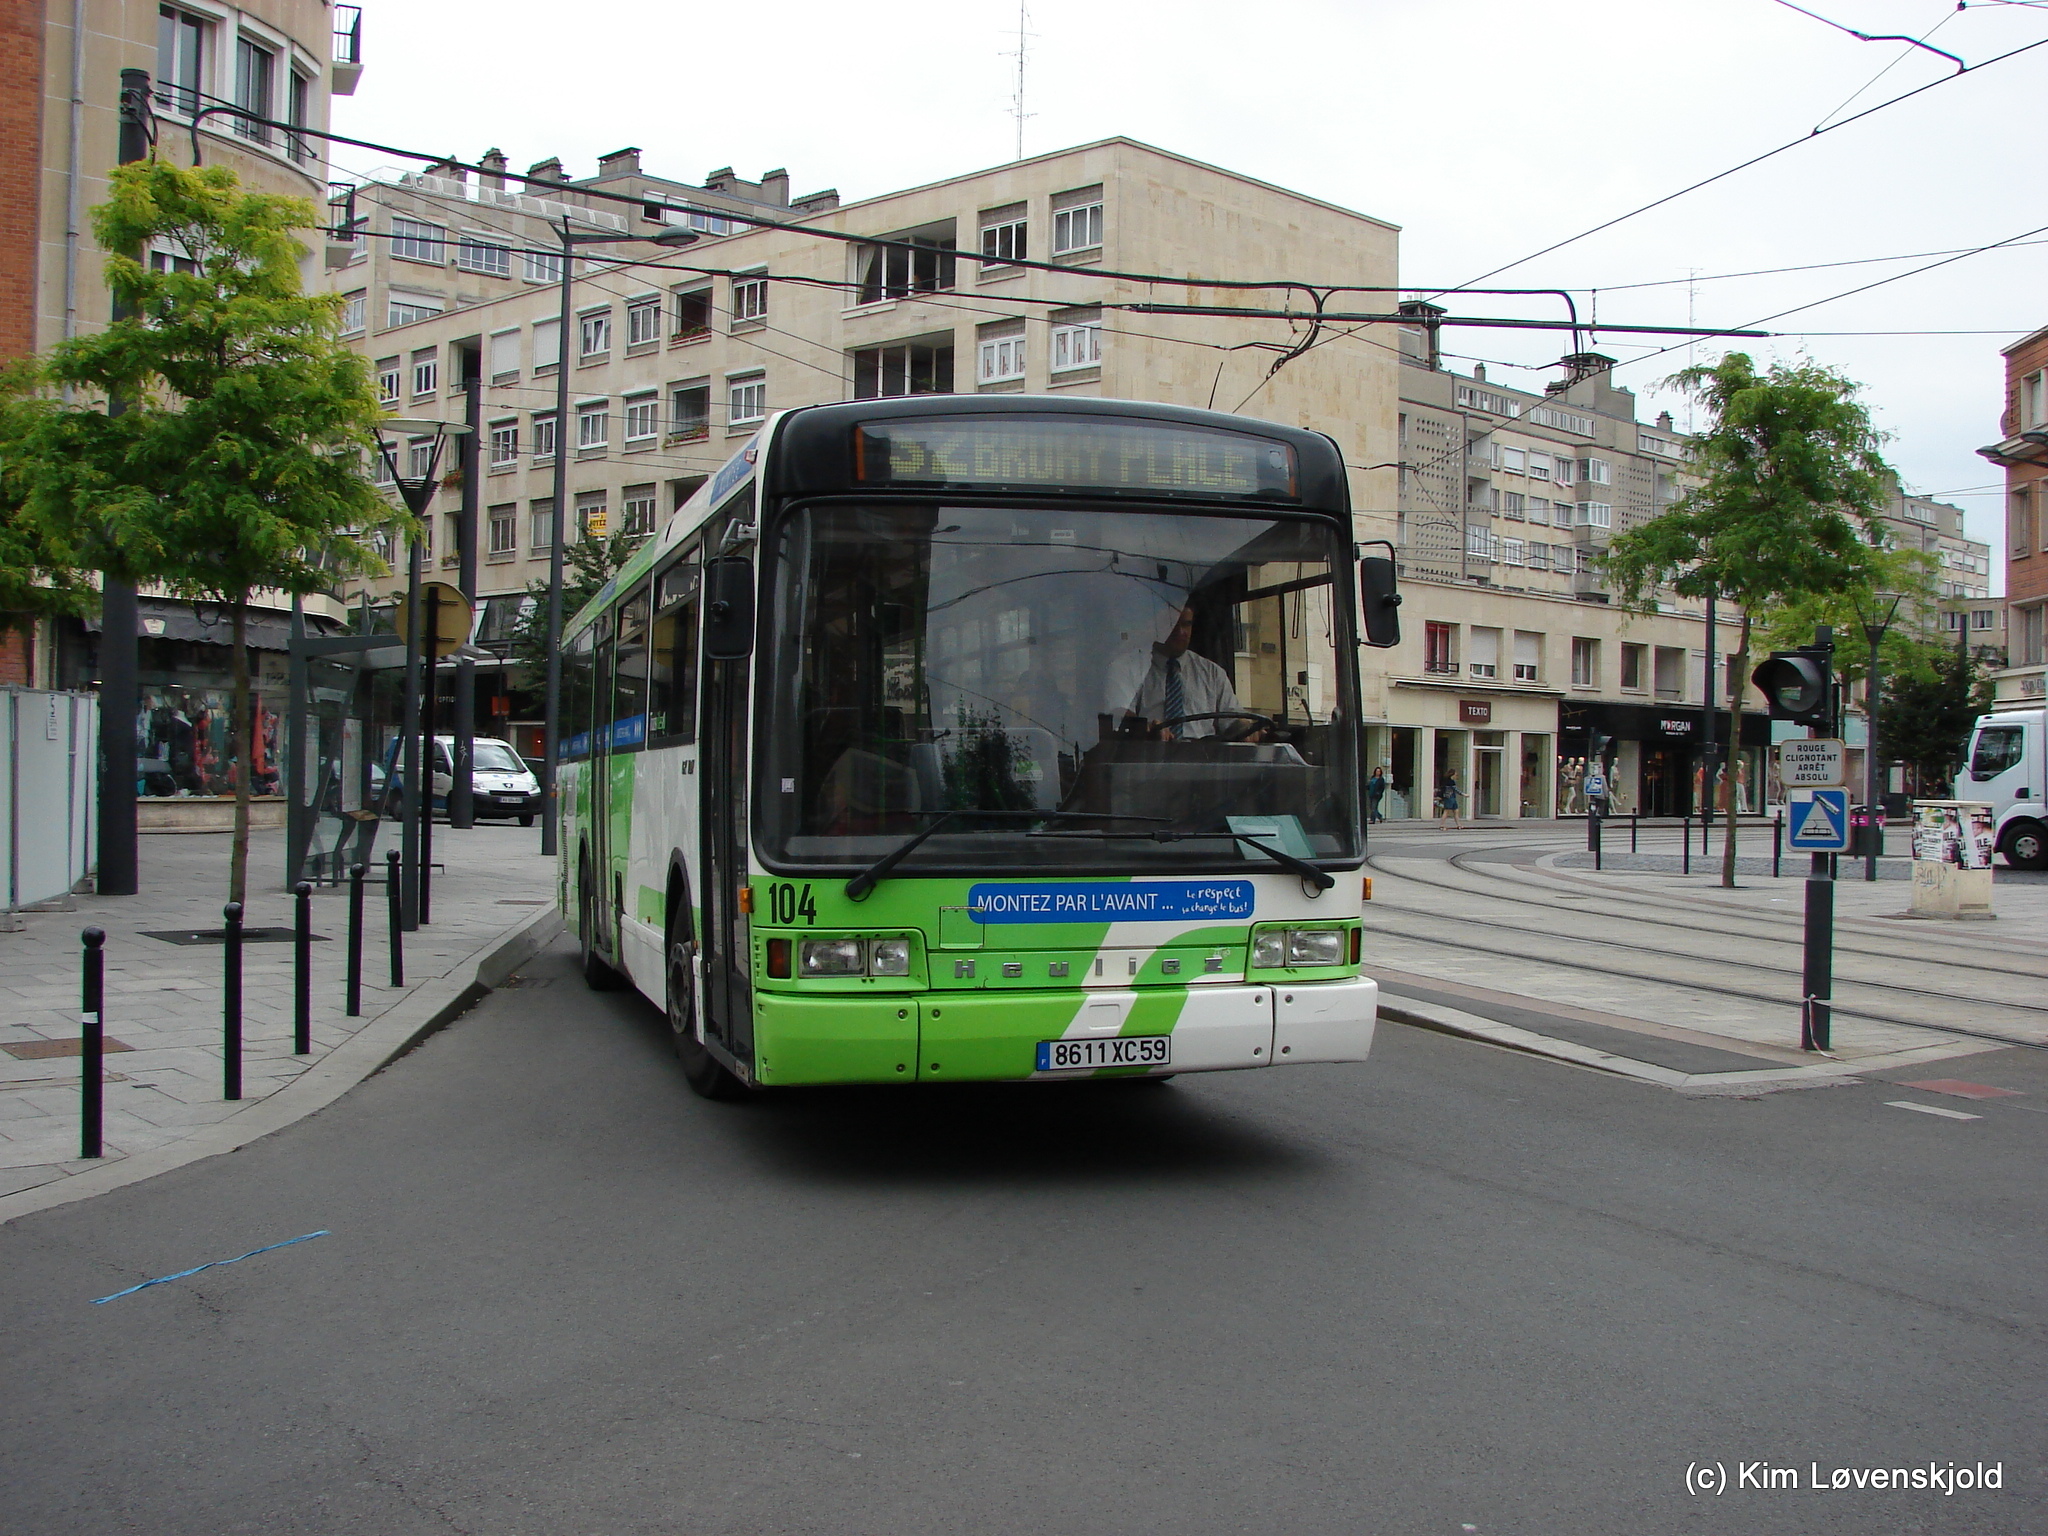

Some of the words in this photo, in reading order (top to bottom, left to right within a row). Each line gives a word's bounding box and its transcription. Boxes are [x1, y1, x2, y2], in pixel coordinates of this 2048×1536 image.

[1467, 706, 1488, 716] TEXTO
[1797, 744, 1826, 752] ROUGE
[1785, 754, 1838, 762] CLIGNOTANT
[1797, 763, 1825, 771] ARRÊT
[1794, 773, 1828, 781] ABSOLU
[1198, 886, 1241, 904] respect
[768, 882, 817, 926] 104
[977, 894, 1051, 913] MONTEZ
[1056, 895, 1088, 911] PAR
[1092, 893, 1159, 911] L'AVANT
[1190, 901, 1218, 916] change
[1228, 901, 1248, 914] bus!
